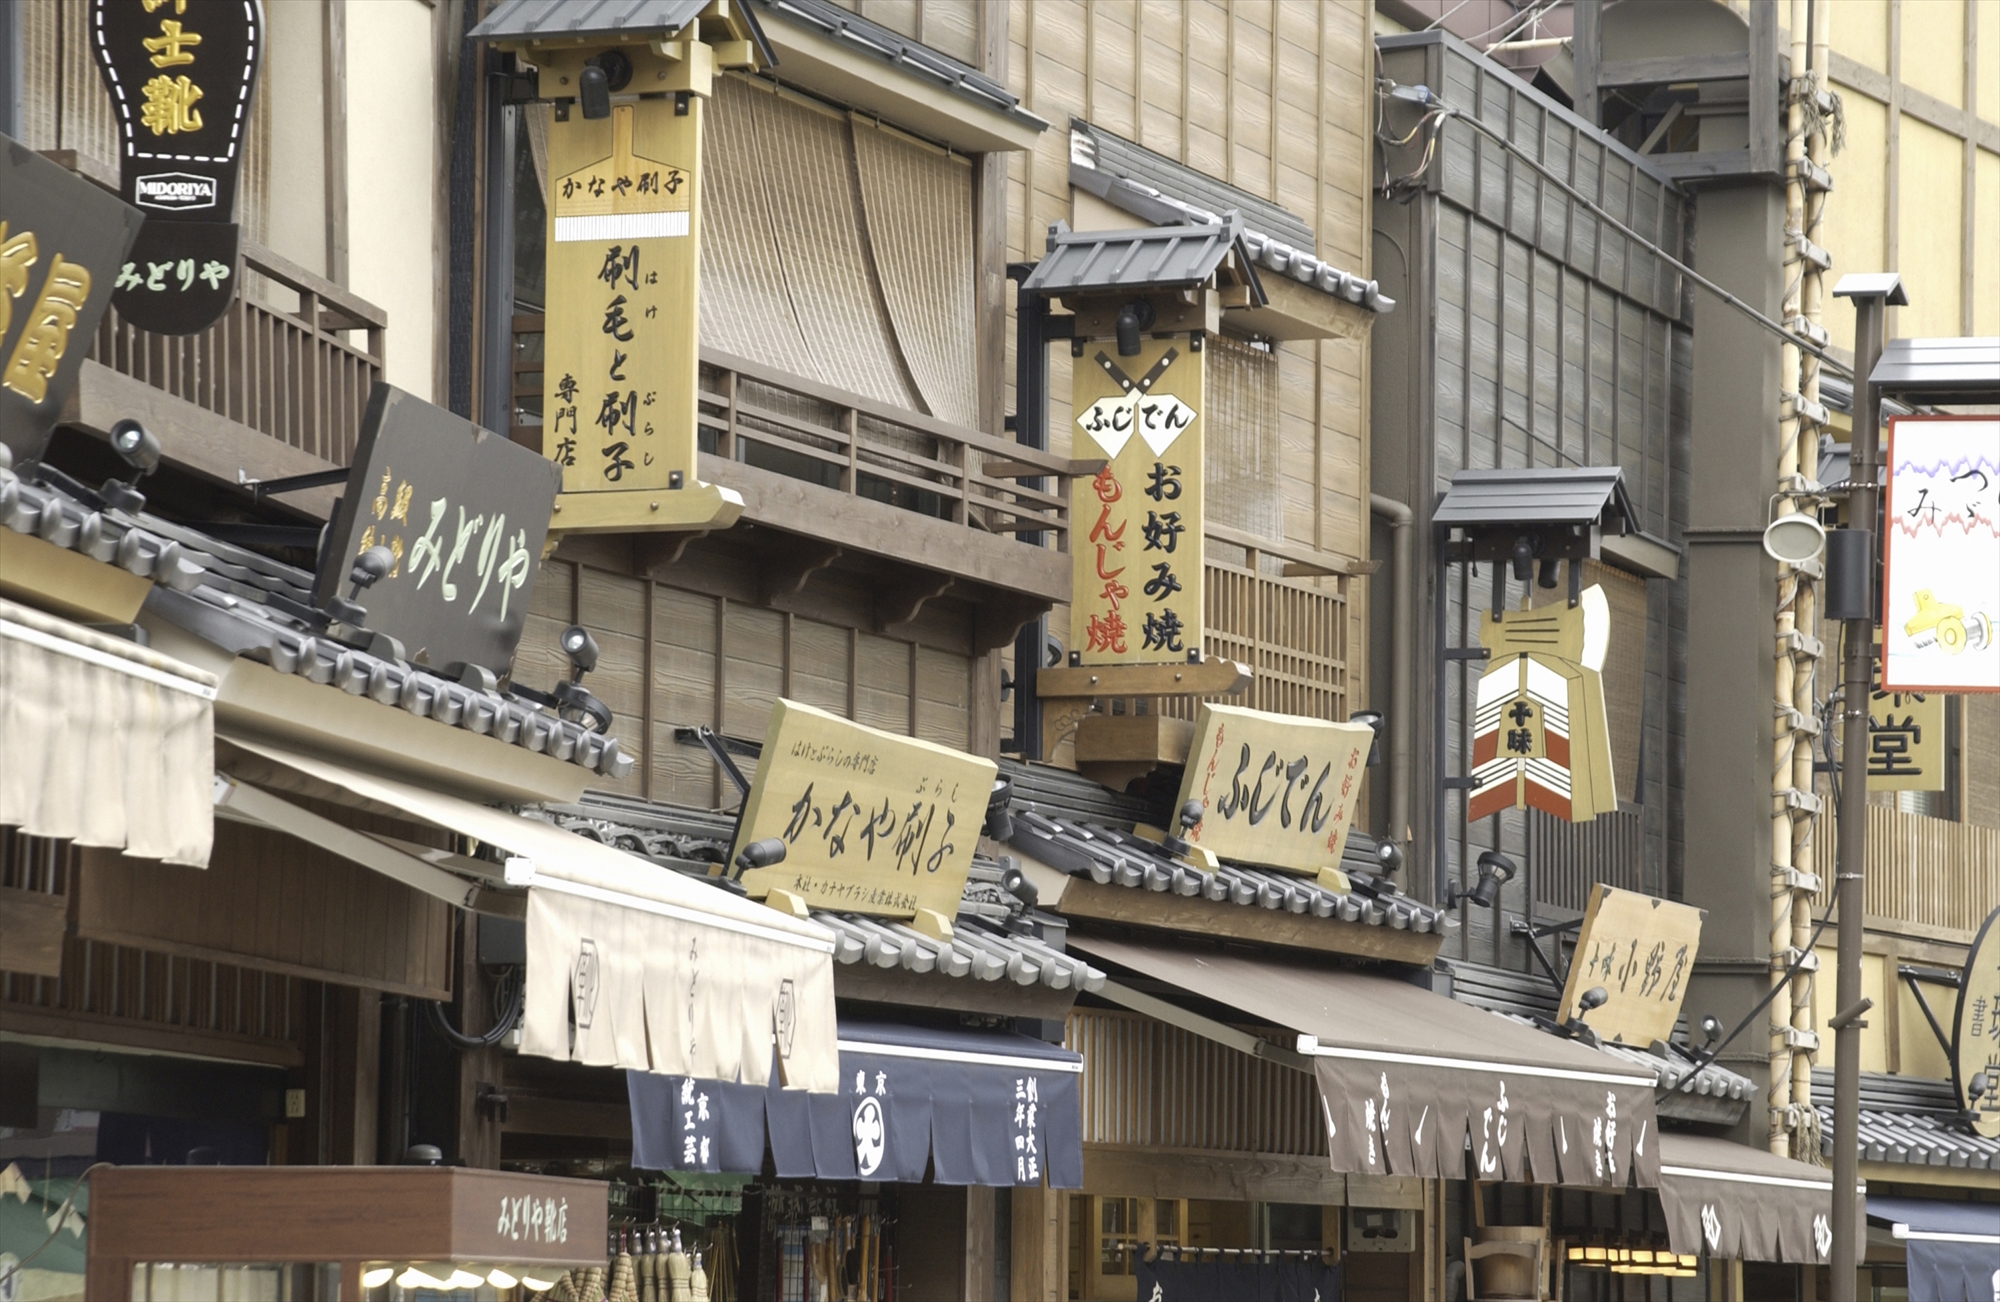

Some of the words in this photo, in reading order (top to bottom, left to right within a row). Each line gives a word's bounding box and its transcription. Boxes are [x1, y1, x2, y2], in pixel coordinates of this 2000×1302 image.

[140, 181, 213, 197] MIDORIYA
[562, 170, 684, 200] かなや刷子
[115, 258, 231, 292] みどりや
[595, 244, 641, 482] 刷毛と刷子
[553, 373, 580, 467] 専門店
[408, 496, 530, 622] みどりや
[1085, 463, 1130, 655] もんじゃ焼
[1141, 462, 1186, 652] お好み焼
[1506, 701, 1533, 755] 十味
[783, 781, 955, 876] かなや刷子
[1216, 742, 1335, 834] ふじでん
[855, 1069, 888, 1096] 東京
